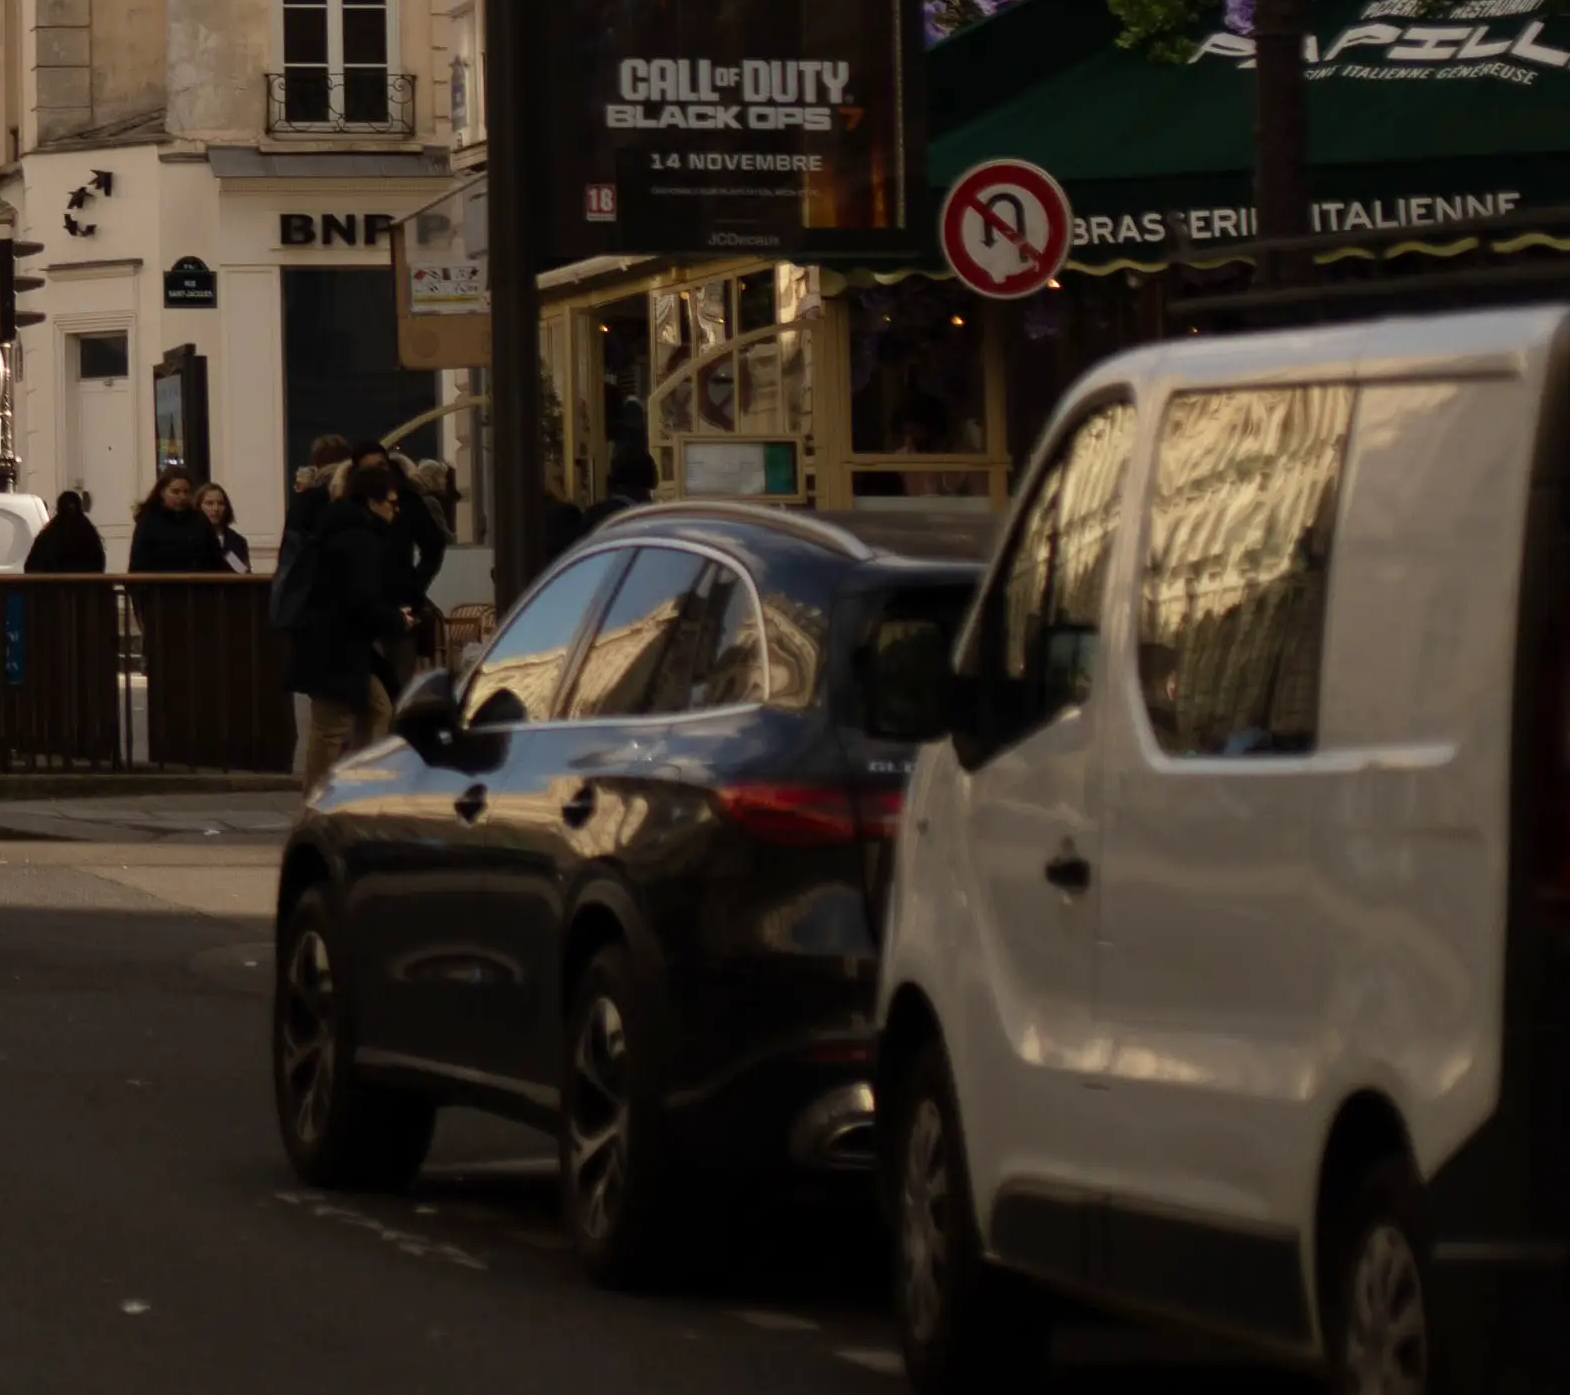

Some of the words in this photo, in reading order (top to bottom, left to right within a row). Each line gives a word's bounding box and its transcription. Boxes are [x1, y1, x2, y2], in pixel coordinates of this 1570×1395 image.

[620, 58, 721, 102] CALL
[716, 67, 742, 87] OF
[743, 60, 850, 104] DUTY
[1342, 65, 1433, 81] ITALIENNE
[605, 105, 744, 130] BLACK
[748, 107, 833, 131] OPS
[837, 108, 865, 132] 7
[651, 154, 682, 170] 14
[690, 154, 824, 172] NOVEMBRE
[590, 187, 614, 212] 18
[279, 213, 396, 246] BNP
